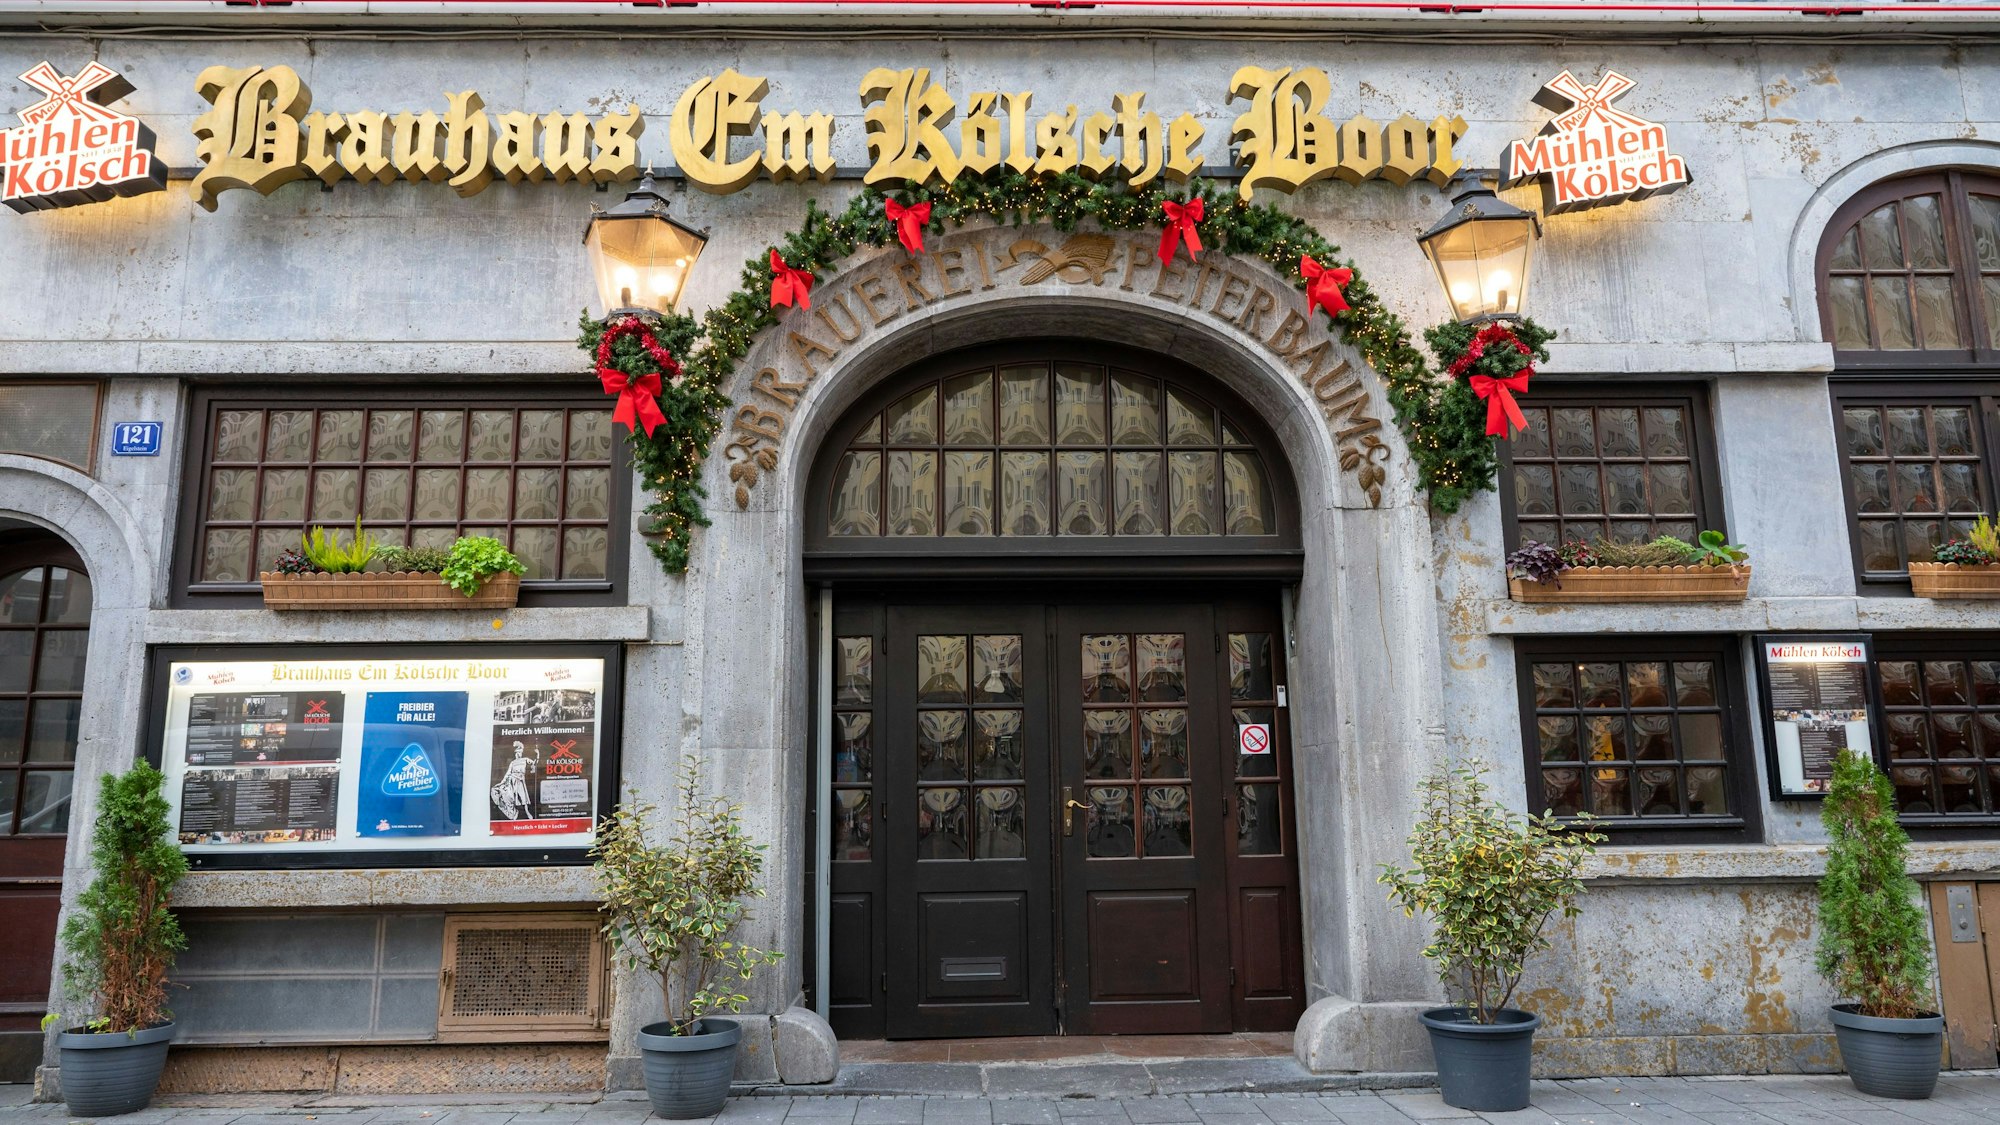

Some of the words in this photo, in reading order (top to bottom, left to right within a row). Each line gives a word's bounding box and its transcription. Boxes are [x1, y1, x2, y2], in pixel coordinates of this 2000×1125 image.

[29, 100, 59, 125] Malz
[1562, 108, 1588, 132] Malz
[190, 65, 645, 213] Brauhaus
[669, 67, 836, 195] Em
[860, 67, 1206, 192] Kölsche
[1225, 66, 1469, 202] Boor
[1513, 125, 1664, 176] Mühlen
[6, 144, 147, 197] Kölsch
[1556, 150, 1684, 202] Kölsch
[734, 241, 995, 440] BRAUEREI
[1119, 241, 1382, 445] PETERBAUM
[121, 425, 152, 445] 121
[1770, 646, 1818, 658] Mühlen
[1822, 645, 1862, 658] Kölsch
[272, 663, 352, 682] Brauhaus
[358, 664, 387, 681] Em
[395, 663, 460, 682] Kölsche
[467, 662, 509, 681] Boor
[396, 711, 412, 721] FÜR
[413, 712, 435, 721] ALLE!
[398, 702, 434, 711] FREIBIER
[501, 727, 532, 736] Herzlich
[534, 726, 585, 735] Willkommen!
[388, 768, 429, 784] Mühlen
[545, 763, 582, 775] BOOR
[397, 776, 434, 790] Freibier
